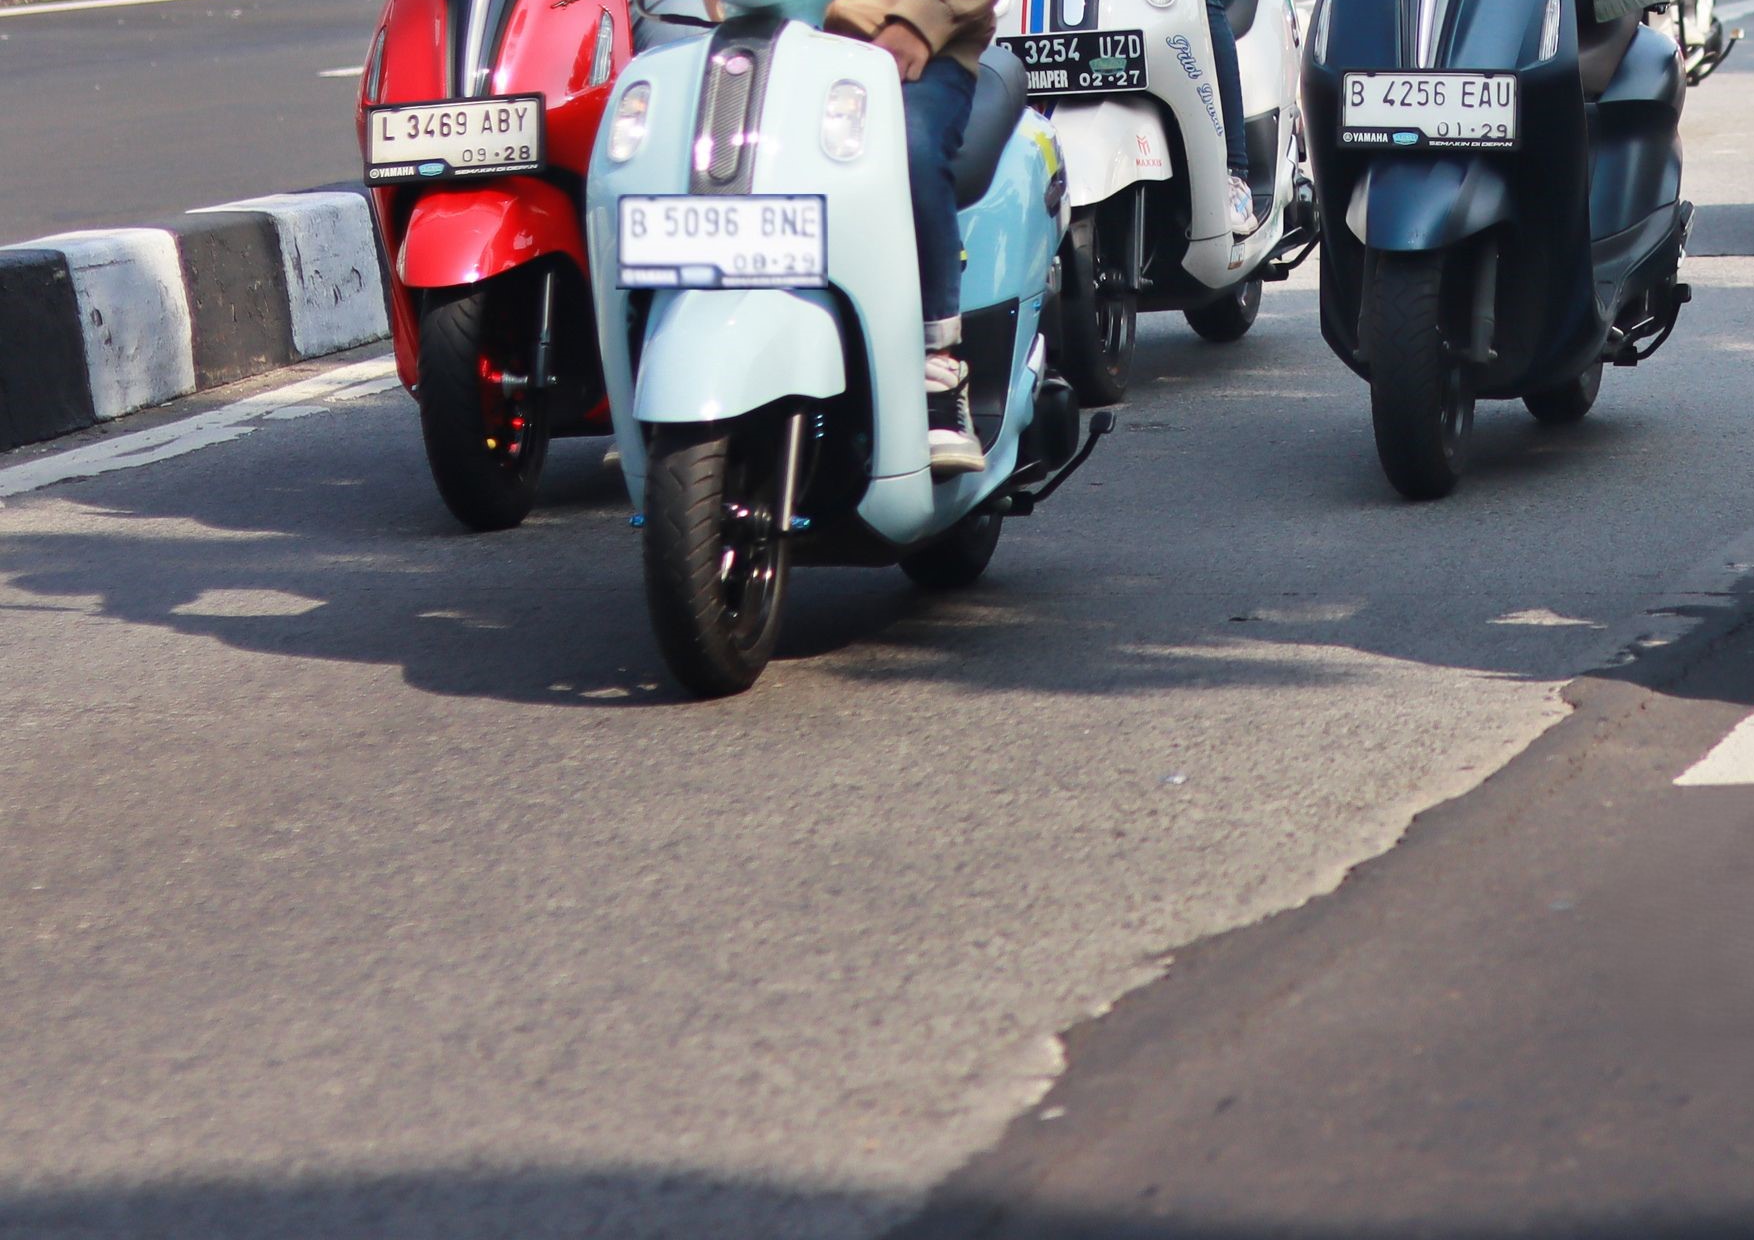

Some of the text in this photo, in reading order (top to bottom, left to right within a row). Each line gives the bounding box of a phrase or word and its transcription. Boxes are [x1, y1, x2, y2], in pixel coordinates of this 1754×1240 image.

[1025, 37, 1081, 64] 3254
[1099, 35, 1141, 59] UZD
[1351, 80, 1510, 108] B 4256 EAU
[382, 107, 528, 141] L 3469 ABY
[1353, 132, 1389, 143] YAMAHA
[379, 166, 415, 178] YAMAHA
[1135, 158, 1162, 167] MAXXIS
[631, 206, 816, 238] B 5096 BNE
